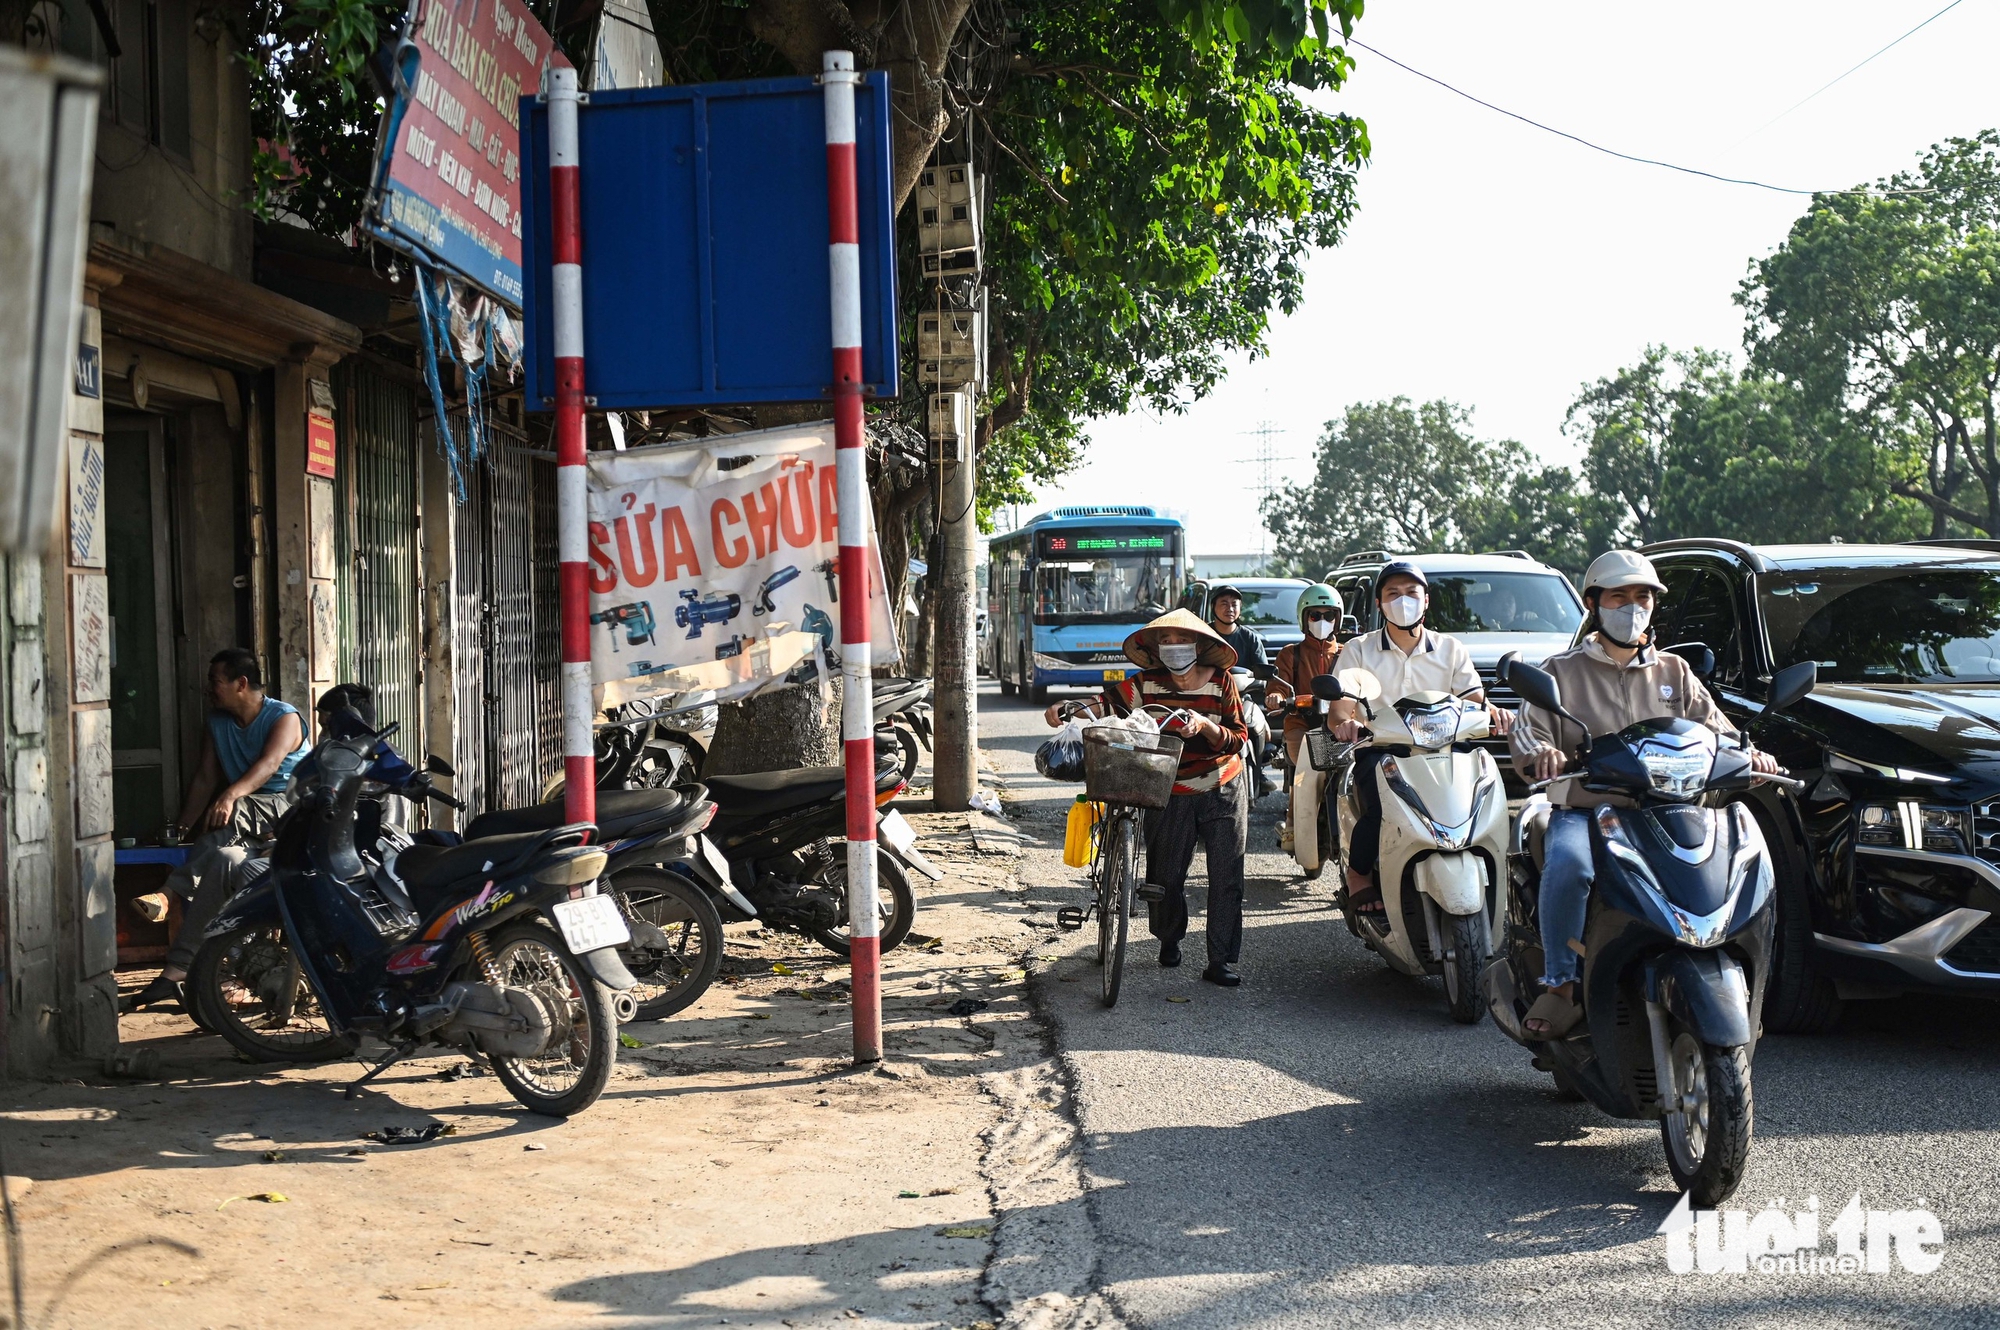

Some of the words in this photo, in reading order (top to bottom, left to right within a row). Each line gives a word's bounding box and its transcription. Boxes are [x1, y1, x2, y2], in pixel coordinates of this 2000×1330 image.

[422, 0, 453, 62] MUA
[450, 17, 480, 84] BÁN
[474, 39, 499, 107] SỬA
[415, 70, 440, 112] MÁY
[435, 86, 467, 137] KHOAN
[437, 149, 459, 188] NÉN
[455, 164, 474, 199] KHÍ
[473, 179, 493, 215] BƠM
[489, 193, 510, 229] NƯỚC
[588, 492, 702, 594] SỬA
[455, 889, 510, 926] Wave
